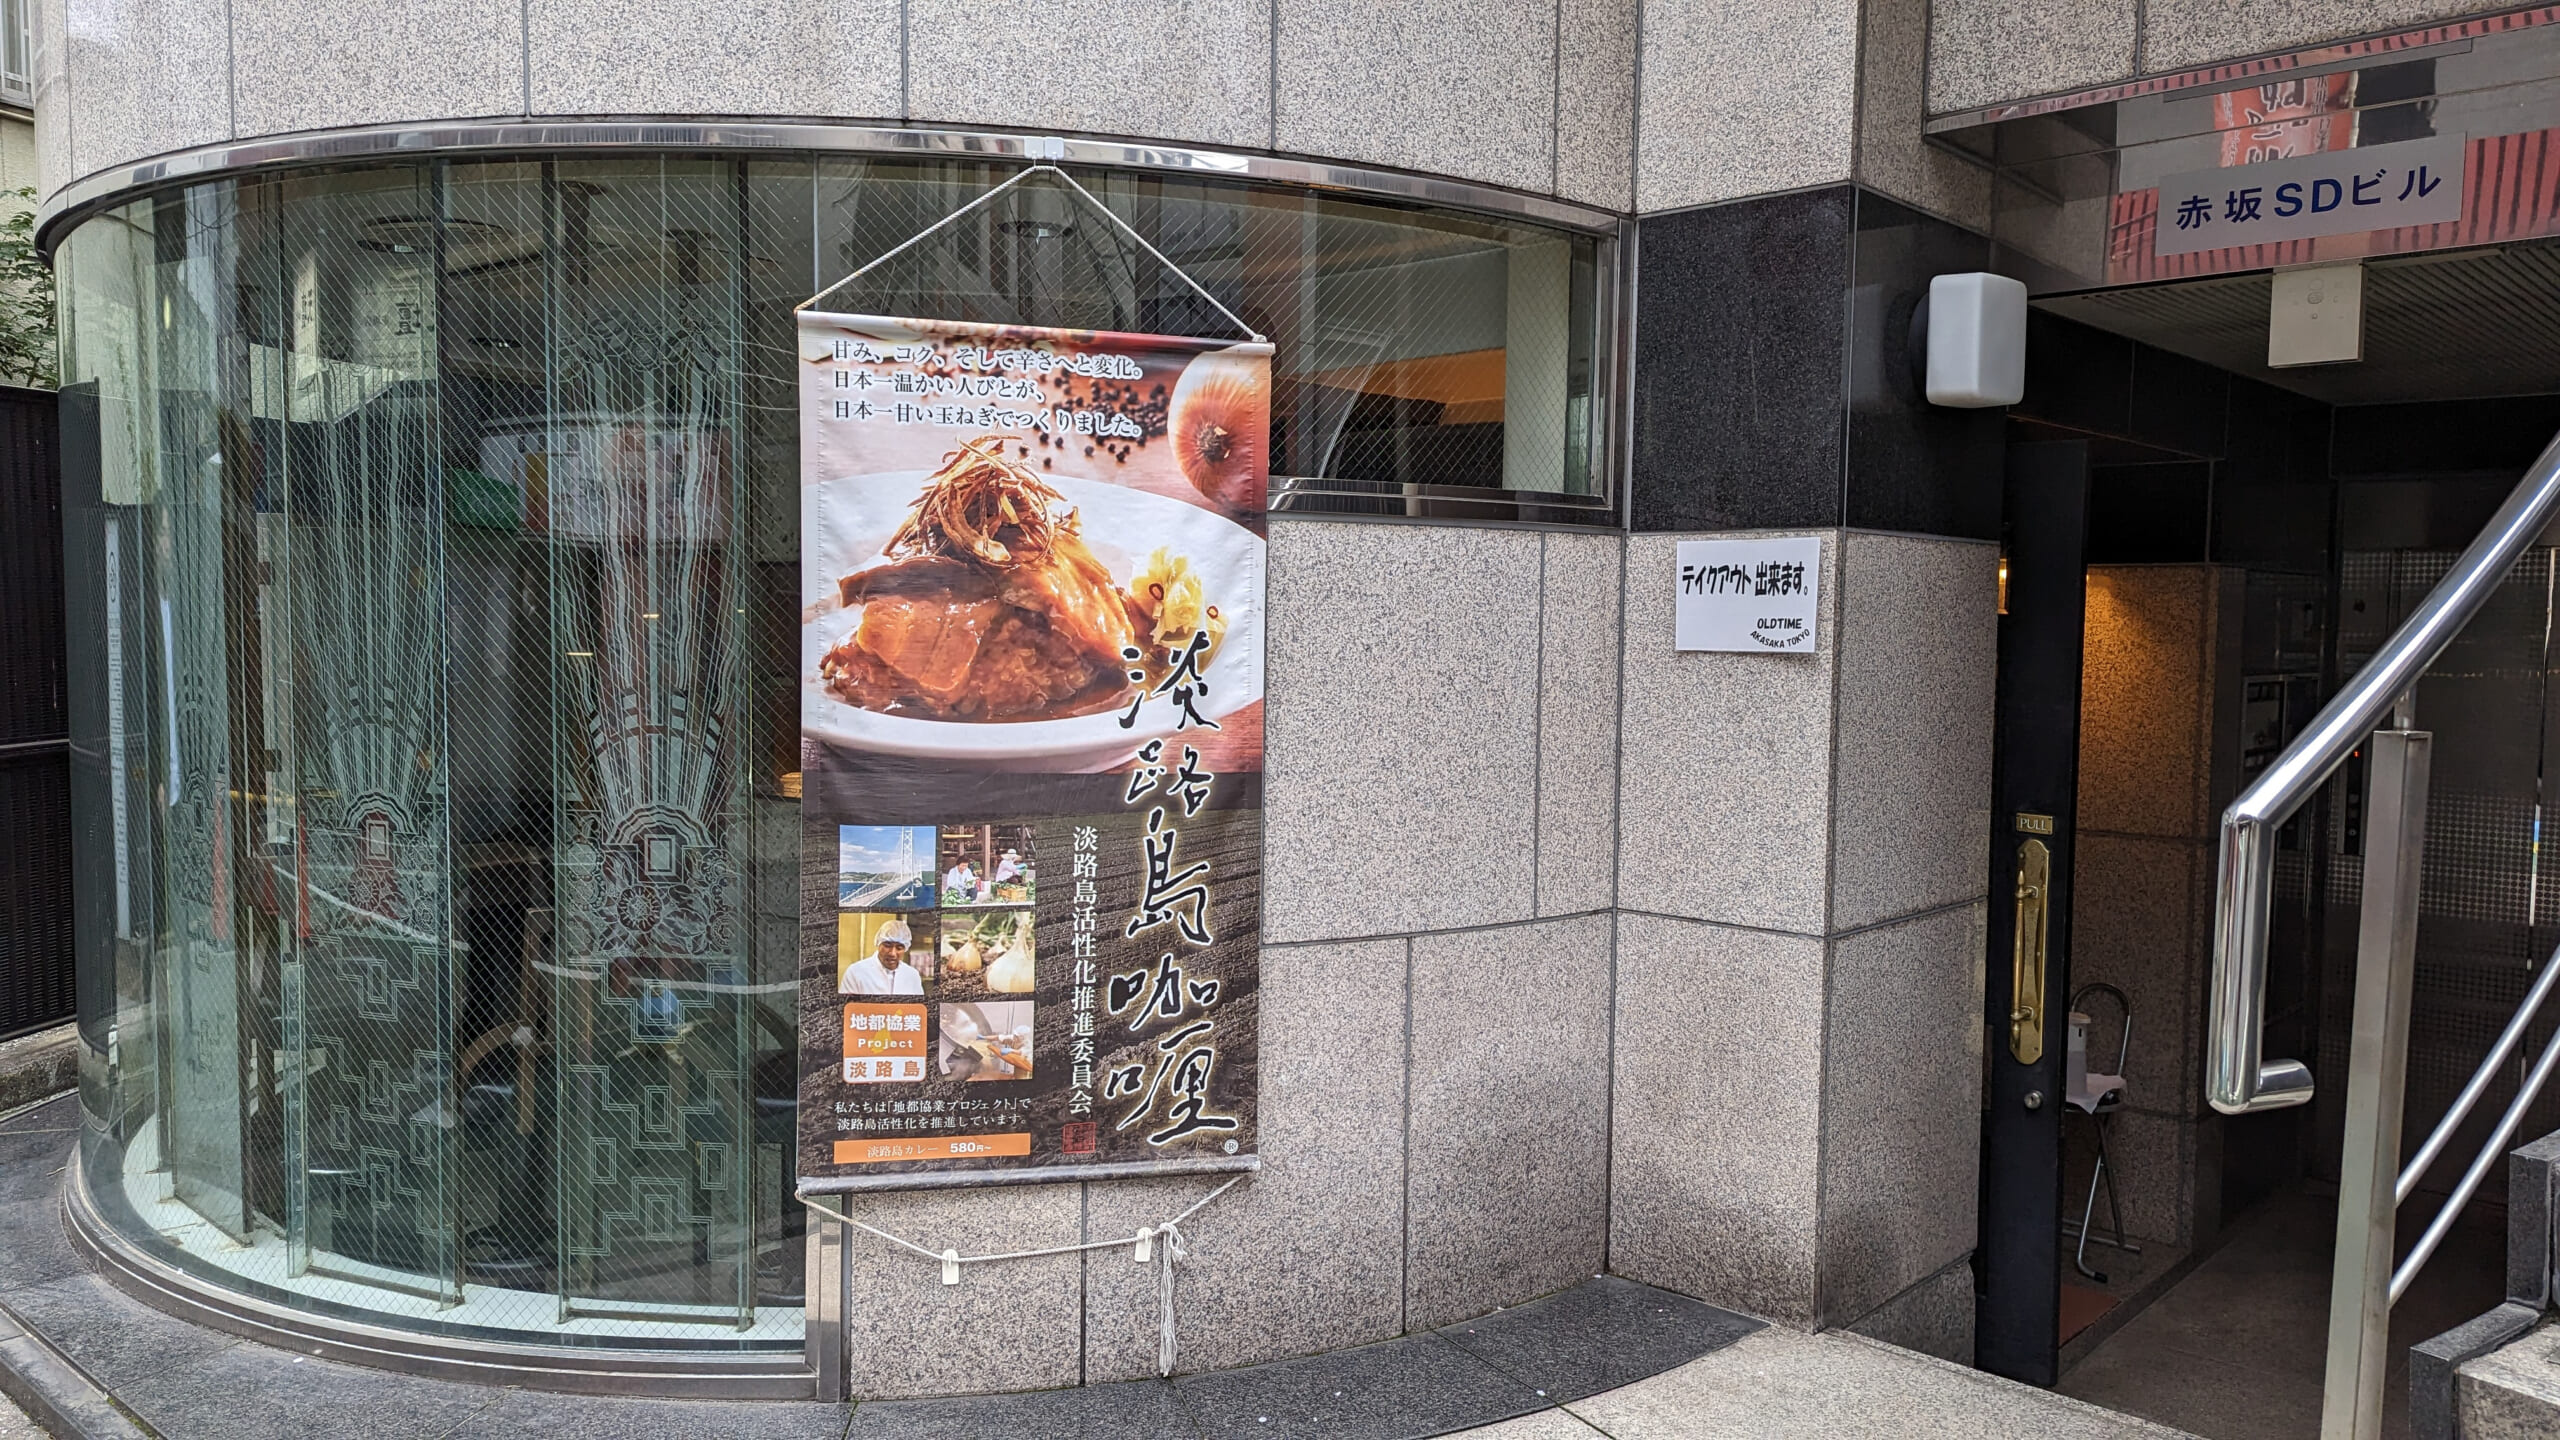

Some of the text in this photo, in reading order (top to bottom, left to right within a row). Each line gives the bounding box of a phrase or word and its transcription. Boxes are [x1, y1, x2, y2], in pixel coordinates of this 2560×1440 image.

[2176, 165, 2441, 230] 赤坂SDビル
[832, 340, 1141, 377] 甘み、コク、そして辛さへと変化。
[834, 370, 1045, 401] 日本一温かい人びとが、
[835, 400, 1140, 435] 日本一甘い玉ねぎでつくりました。
[1757, 617, 1803, 630] OLDTIME
[1750, 628, 1810, 649] AKASAKA TOKYO
[2020, 817, 2047, 831] PULL
[1068, 825, 1098, 1115] 淡路島活性化推進委員会
[850, 1013, 921, 1032] 地都協業
[857, 1038, 913, 1050] Project
[849, 1060, 920, 1078] 淡路島
[836, 1113, 1027, 1132] 淡路島活性化を推進しています。
